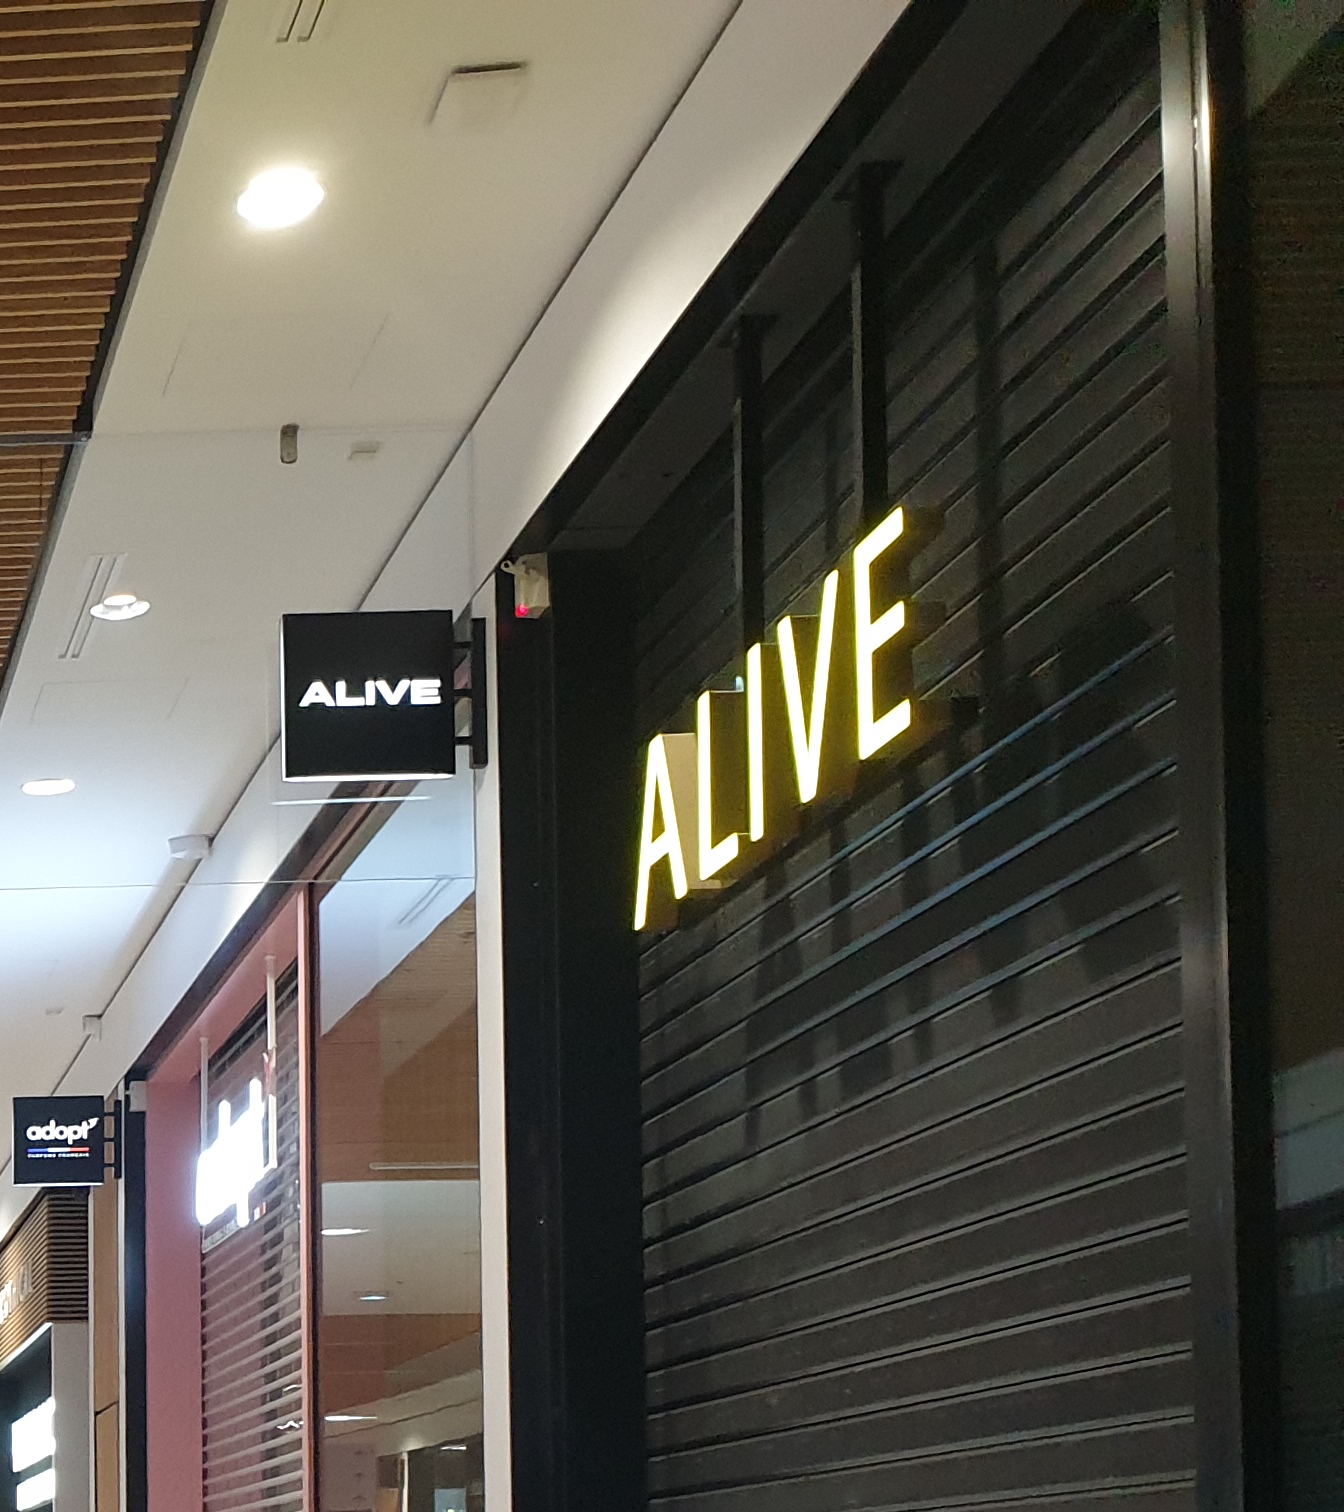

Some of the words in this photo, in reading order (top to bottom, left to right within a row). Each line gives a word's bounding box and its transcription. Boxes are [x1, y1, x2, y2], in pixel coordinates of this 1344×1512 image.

[298, 678, 443, 709] ALIVE
[634, 505, 911, 932] ALIVE
[26, 1118, 95, 1146] adopt
